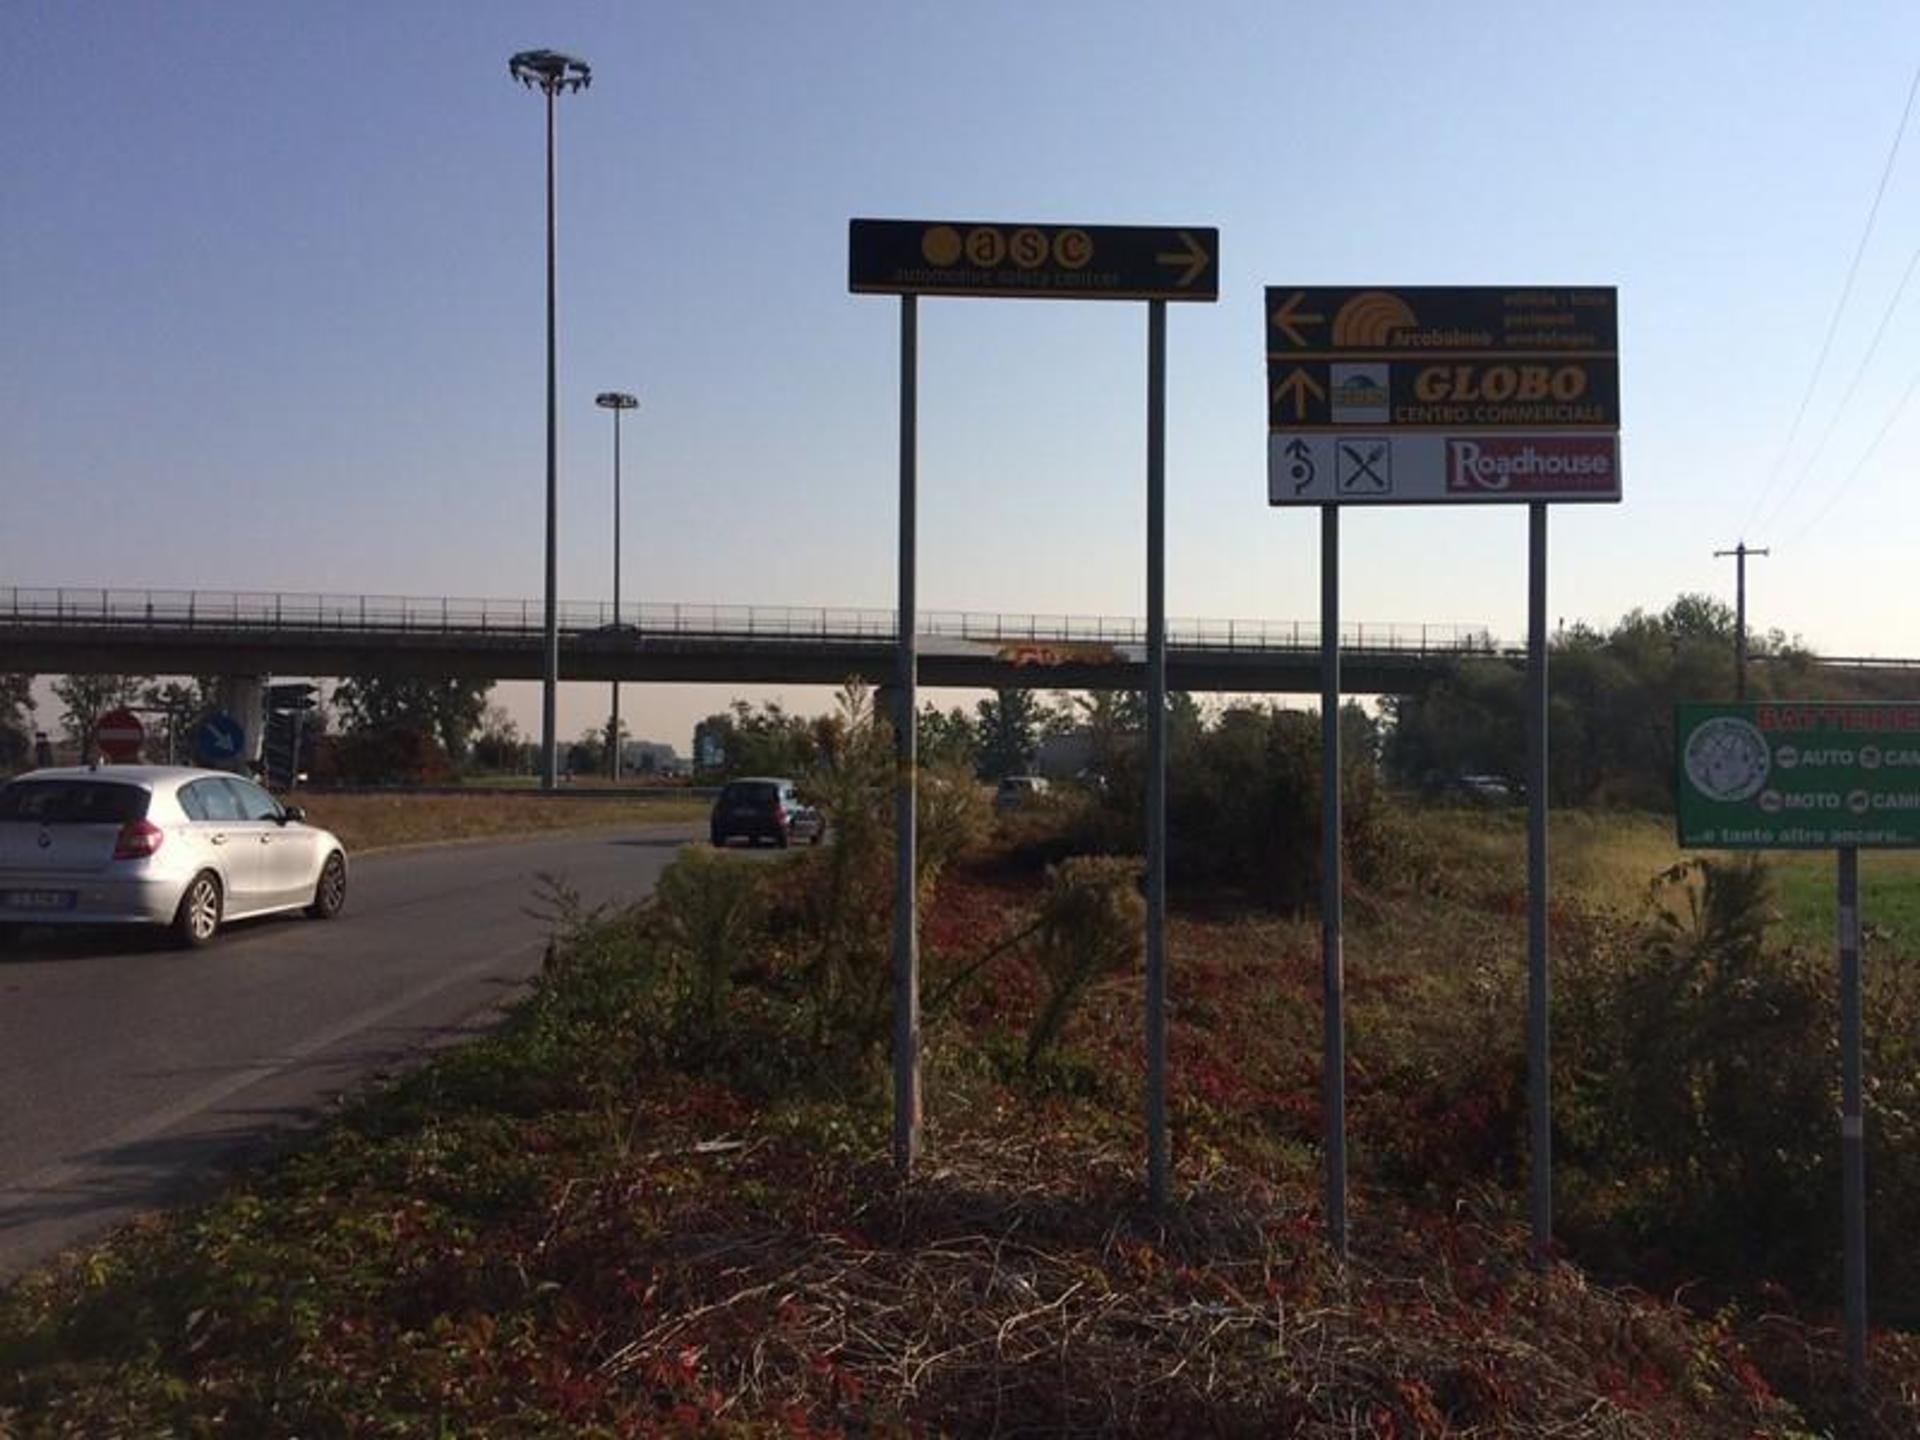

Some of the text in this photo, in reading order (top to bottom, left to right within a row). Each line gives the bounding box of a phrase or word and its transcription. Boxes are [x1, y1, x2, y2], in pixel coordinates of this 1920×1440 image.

[974, 228, 1087, 262] asc
[1416, 365, 1588, 403] GLOBO
[1396, 405, 1604, 423] CENTRO COMMERCIALE
[1450, 441, 1609, 489] Roadhouse
[1801, 750, 1854, 767] AUTO
[1785, 792, 1840, 808] MOTO
